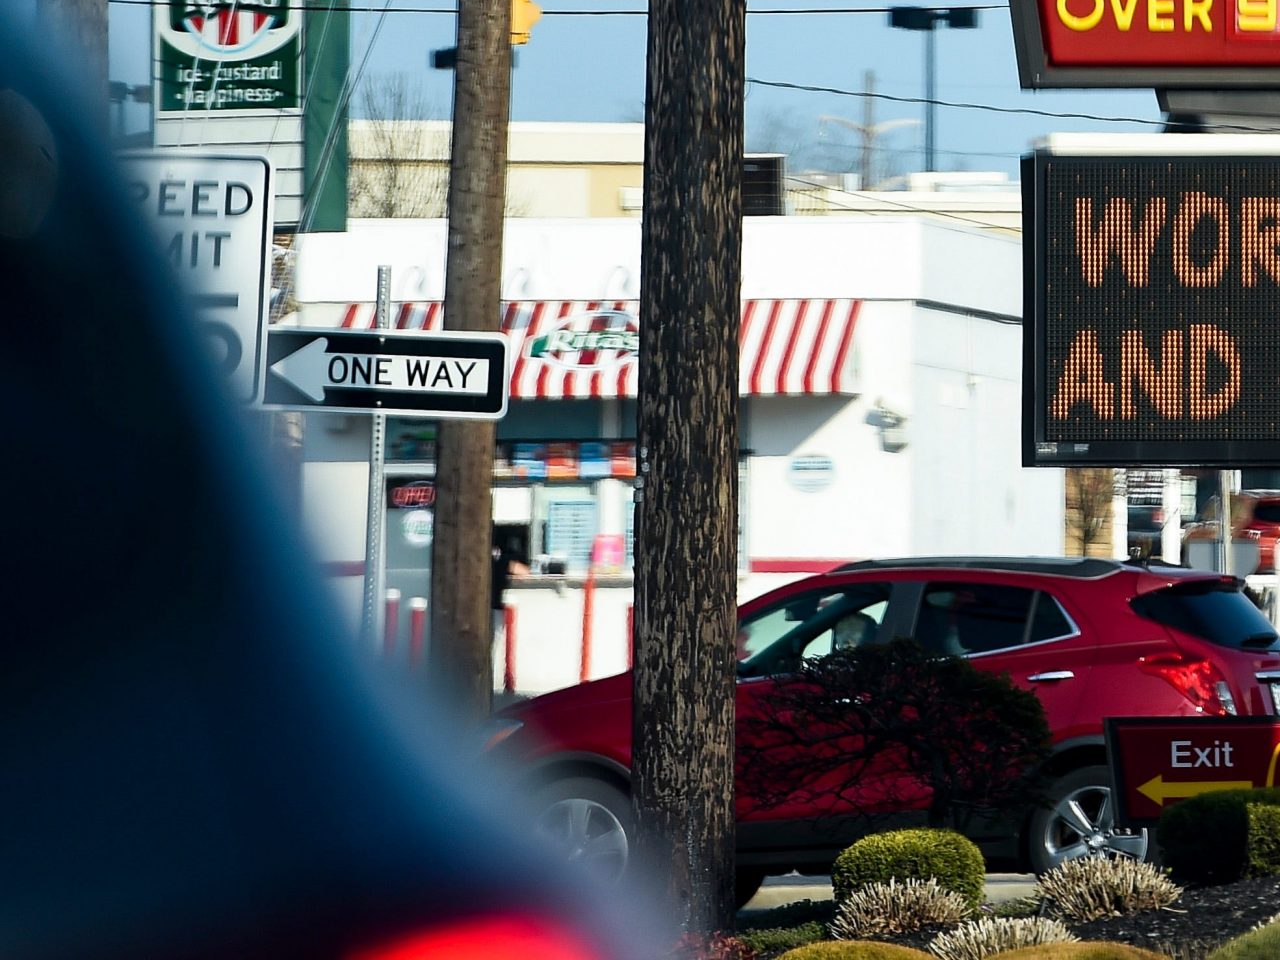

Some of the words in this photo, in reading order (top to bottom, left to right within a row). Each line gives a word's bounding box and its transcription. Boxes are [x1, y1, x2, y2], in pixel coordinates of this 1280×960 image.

[328, 354, 393, 386] ONE
[406, 359, 476, 389] WAY
[1050, 324, 1242, 420] AND
[1171, 740, 1234, 768] Exit
